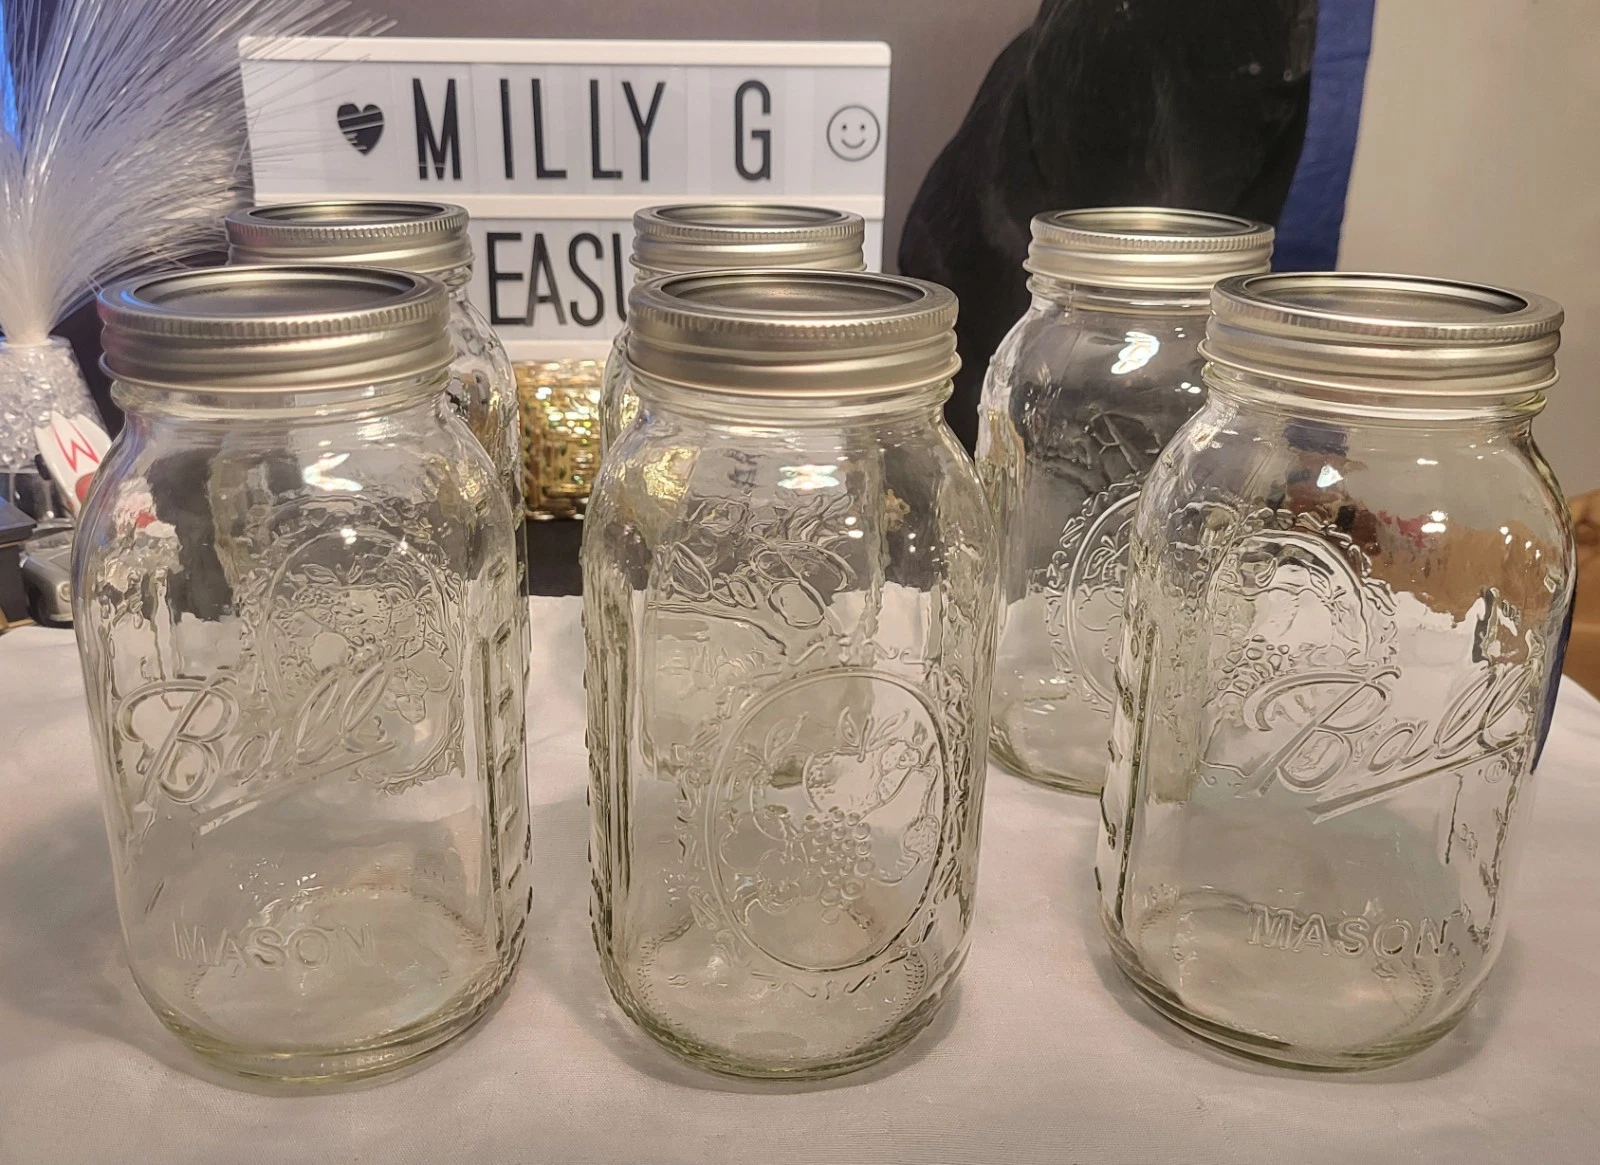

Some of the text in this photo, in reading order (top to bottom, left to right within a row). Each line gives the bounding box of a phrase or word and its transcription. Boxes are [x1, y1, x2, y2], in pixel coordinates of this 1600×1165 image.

[412, 78, 771, 182] MILLY G
[116, 662, 395, 826] Ball
[1243, 664, 1533, 822] Ball
[171, 919, 376, 969] MASON
[1247, 902, 1449, 957] MASON
